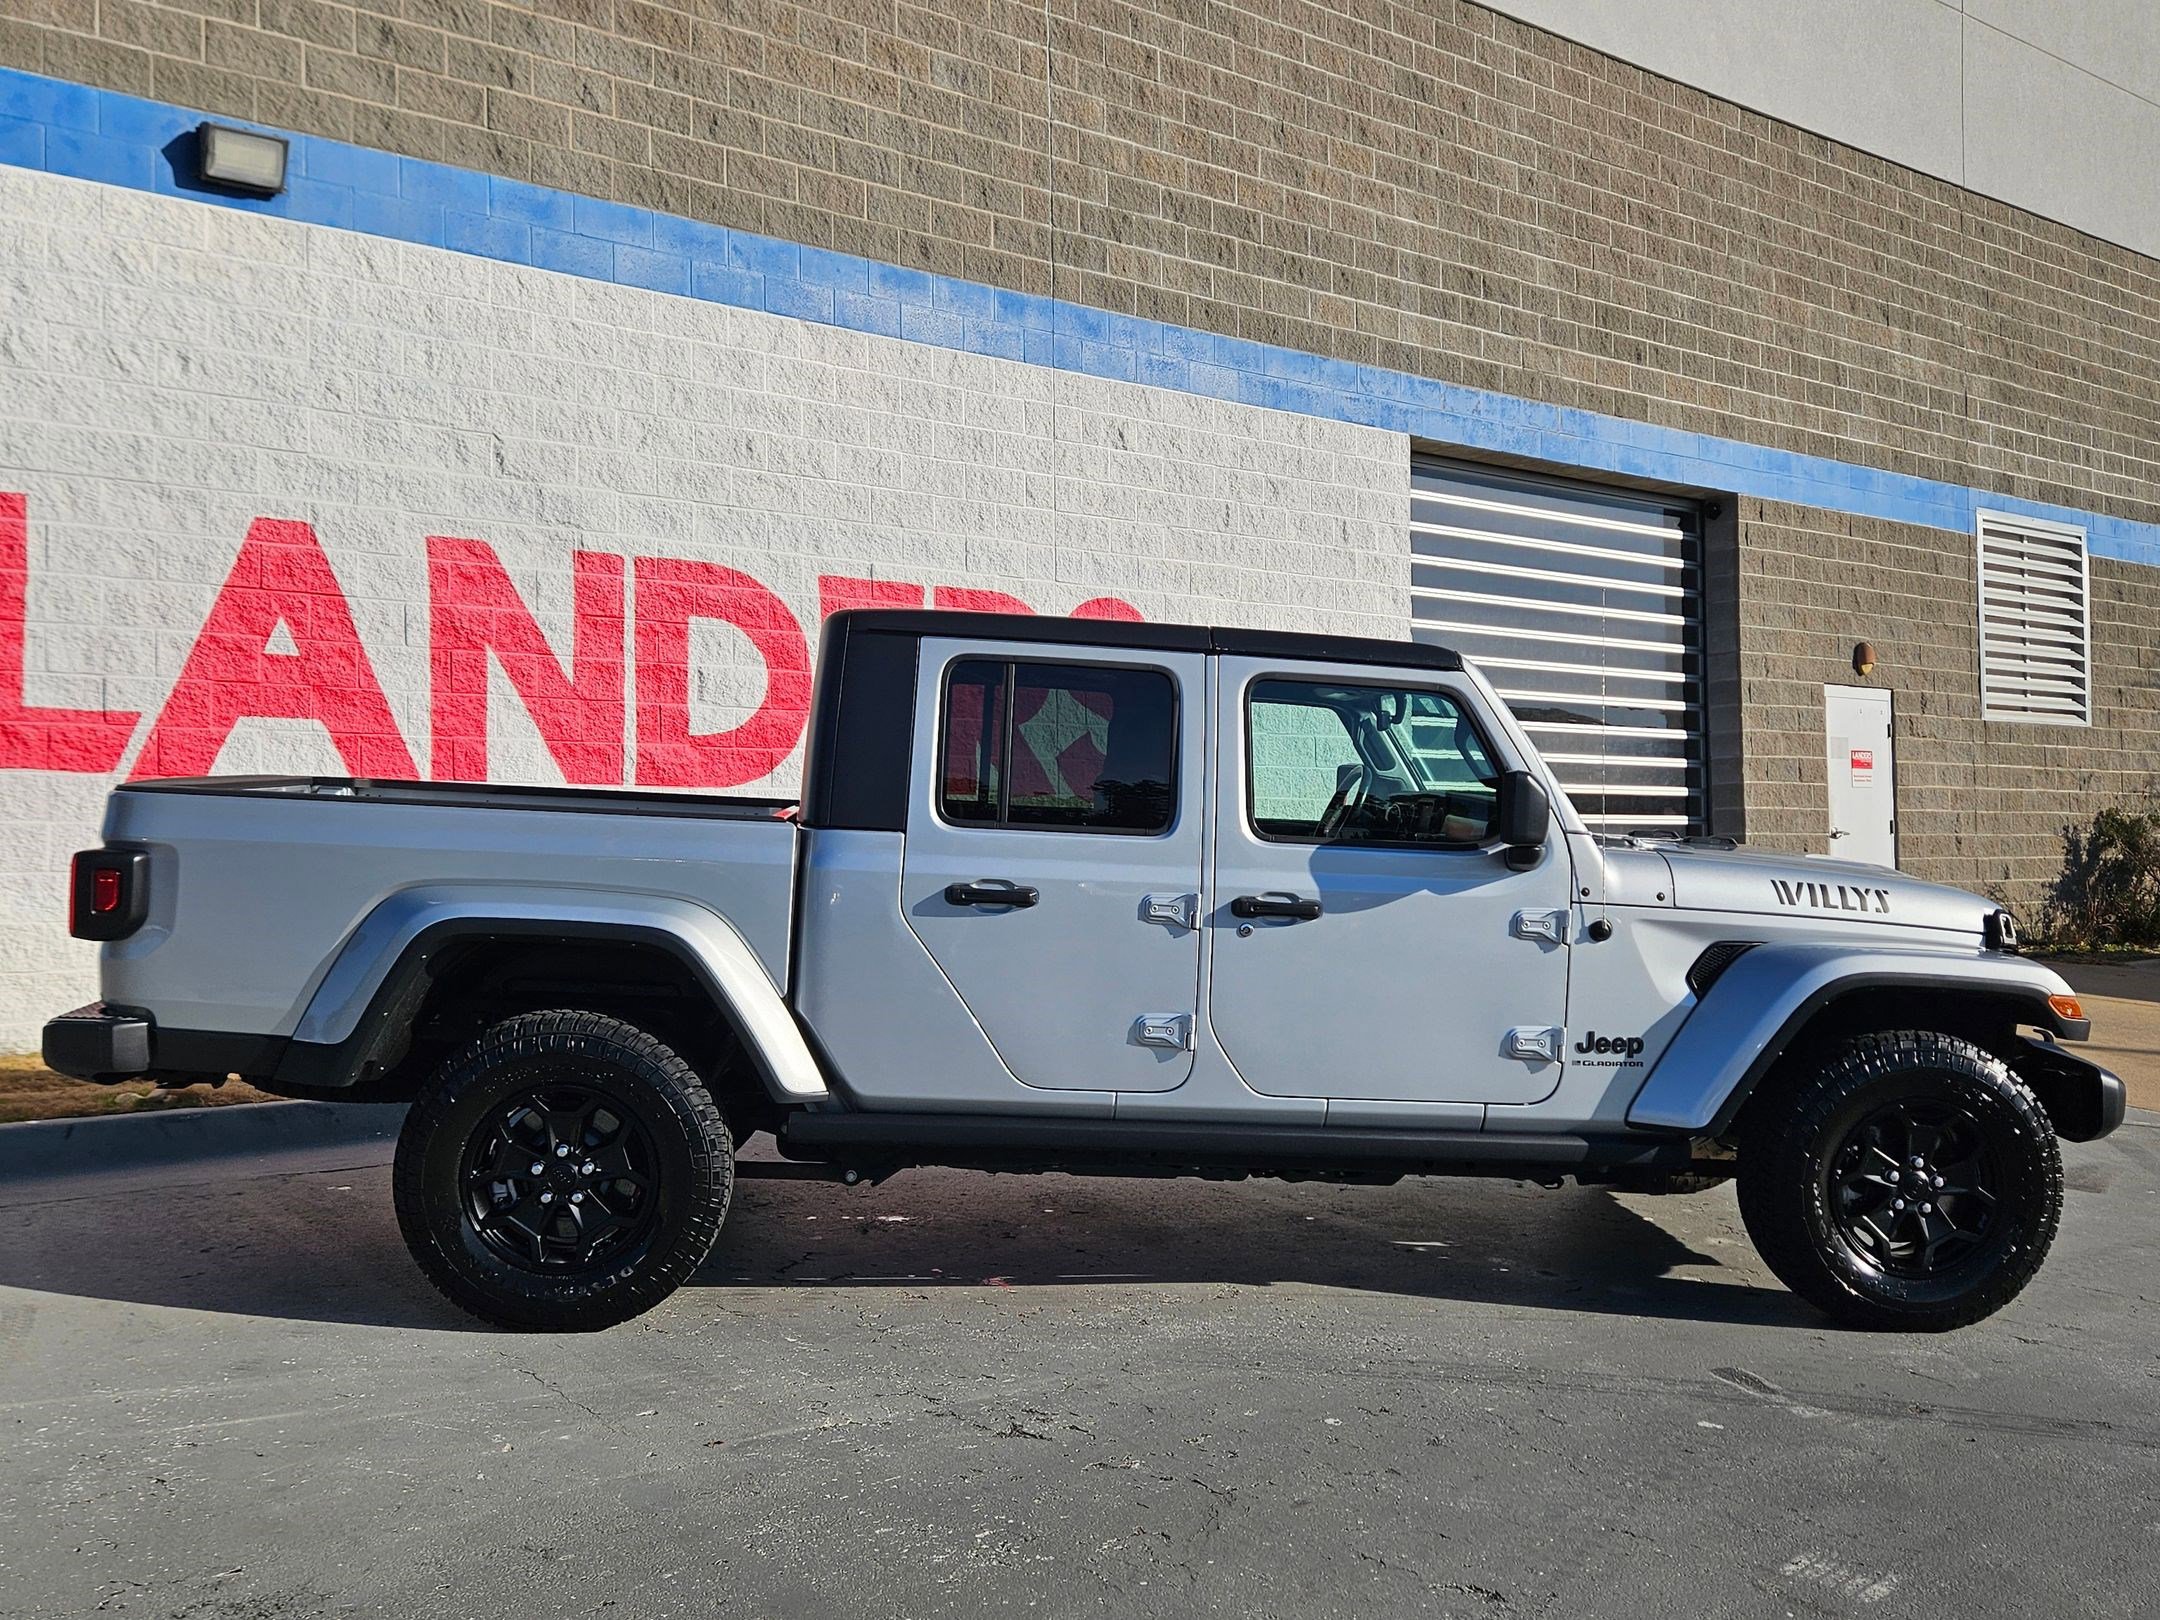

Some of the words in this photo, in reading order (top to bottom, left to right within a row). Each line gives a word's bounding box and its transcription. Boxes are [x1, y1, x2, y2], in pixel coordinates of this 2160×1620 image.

[1770, 879, 1890, 914] WILLYS
[1575, 1030, 1645, 1058] Jeep
[1582, 1059, 1644, 1068] GLADIATOR
